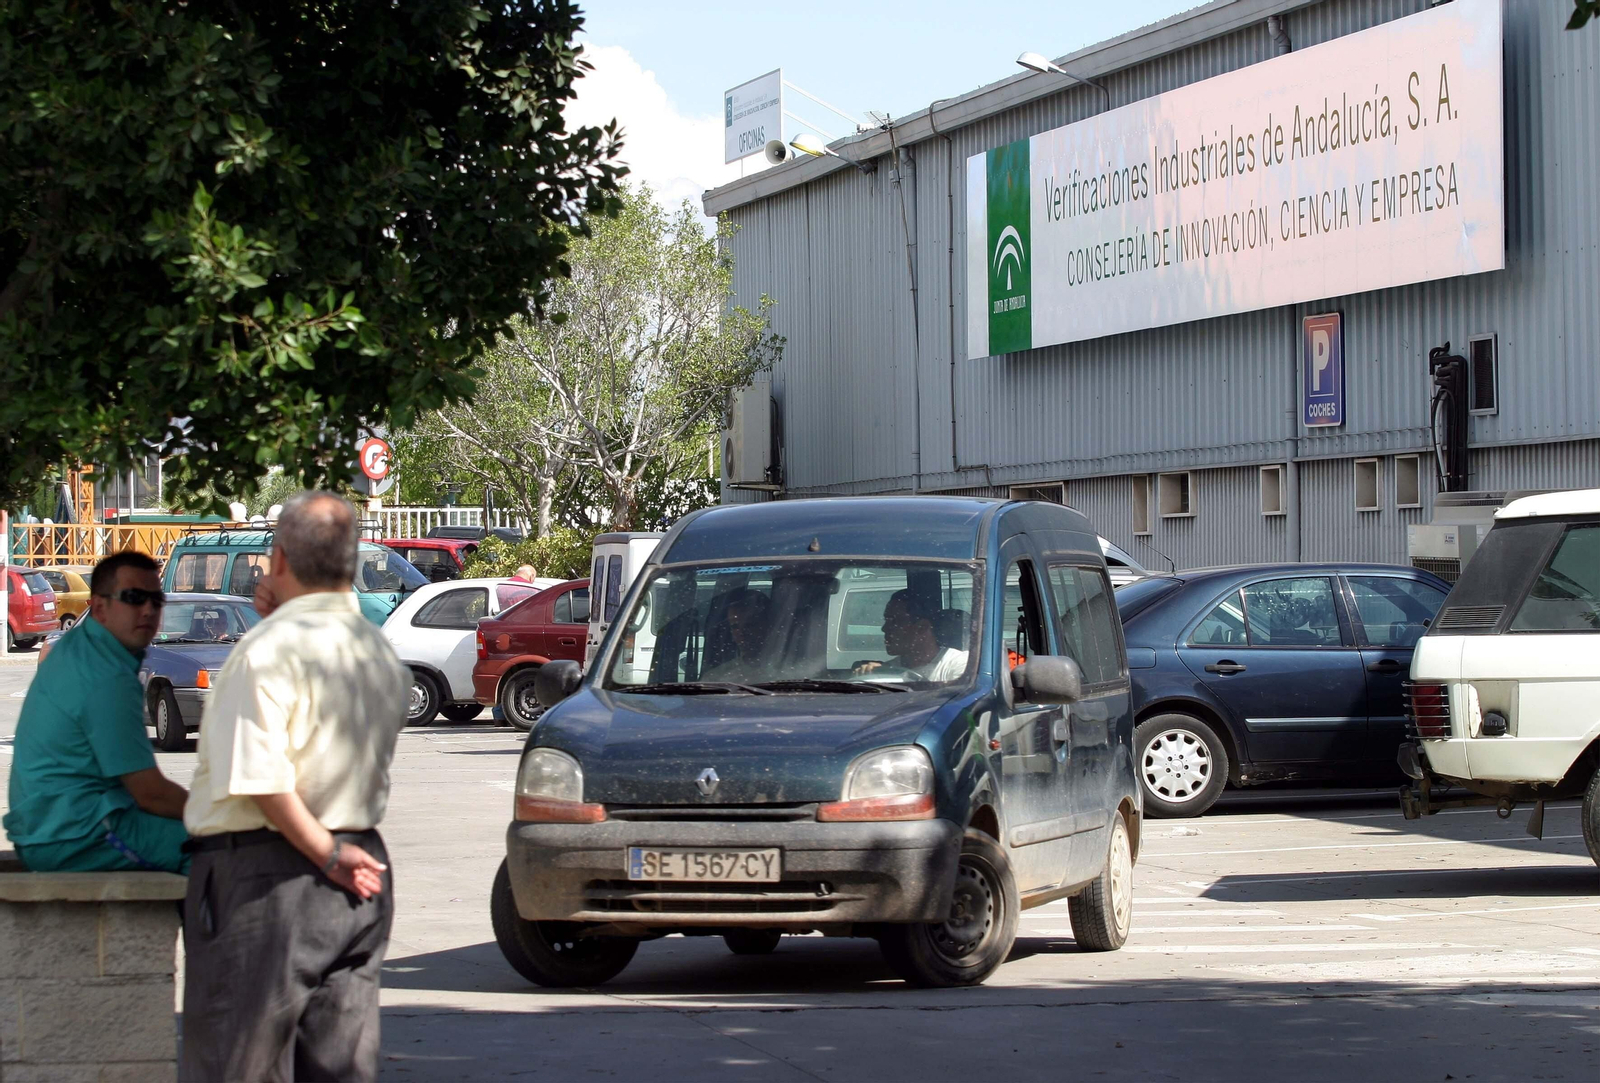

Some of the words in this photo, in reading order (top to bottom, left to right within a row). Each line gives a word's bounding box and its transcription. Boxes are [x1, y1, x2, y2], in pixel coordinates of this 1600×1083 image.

[739, 126, 766, 153] OFICINAS
[1044, 161, 1149, 223] Verificaciones
[1154, 124, 1256, 195] Industriales
[1262, 113, 1284, 167] de
[1291, 84, 1398, 161] Andalucía,
[1067, 226, 1149, 287] CONSEJERÍA
[1153, 228, 1171, 268] DE
[1175, 200, 1274, 264] INNOVACIÓN,
[1280, 187, 1350, 242] CIENCIA
[1355, 183, 1365, 226] Y
[1371, 162, 1459, 223] EMPRESA
[1312, 329, 1330, 391] P
[1308, 402, 1336, 417] COCHES
